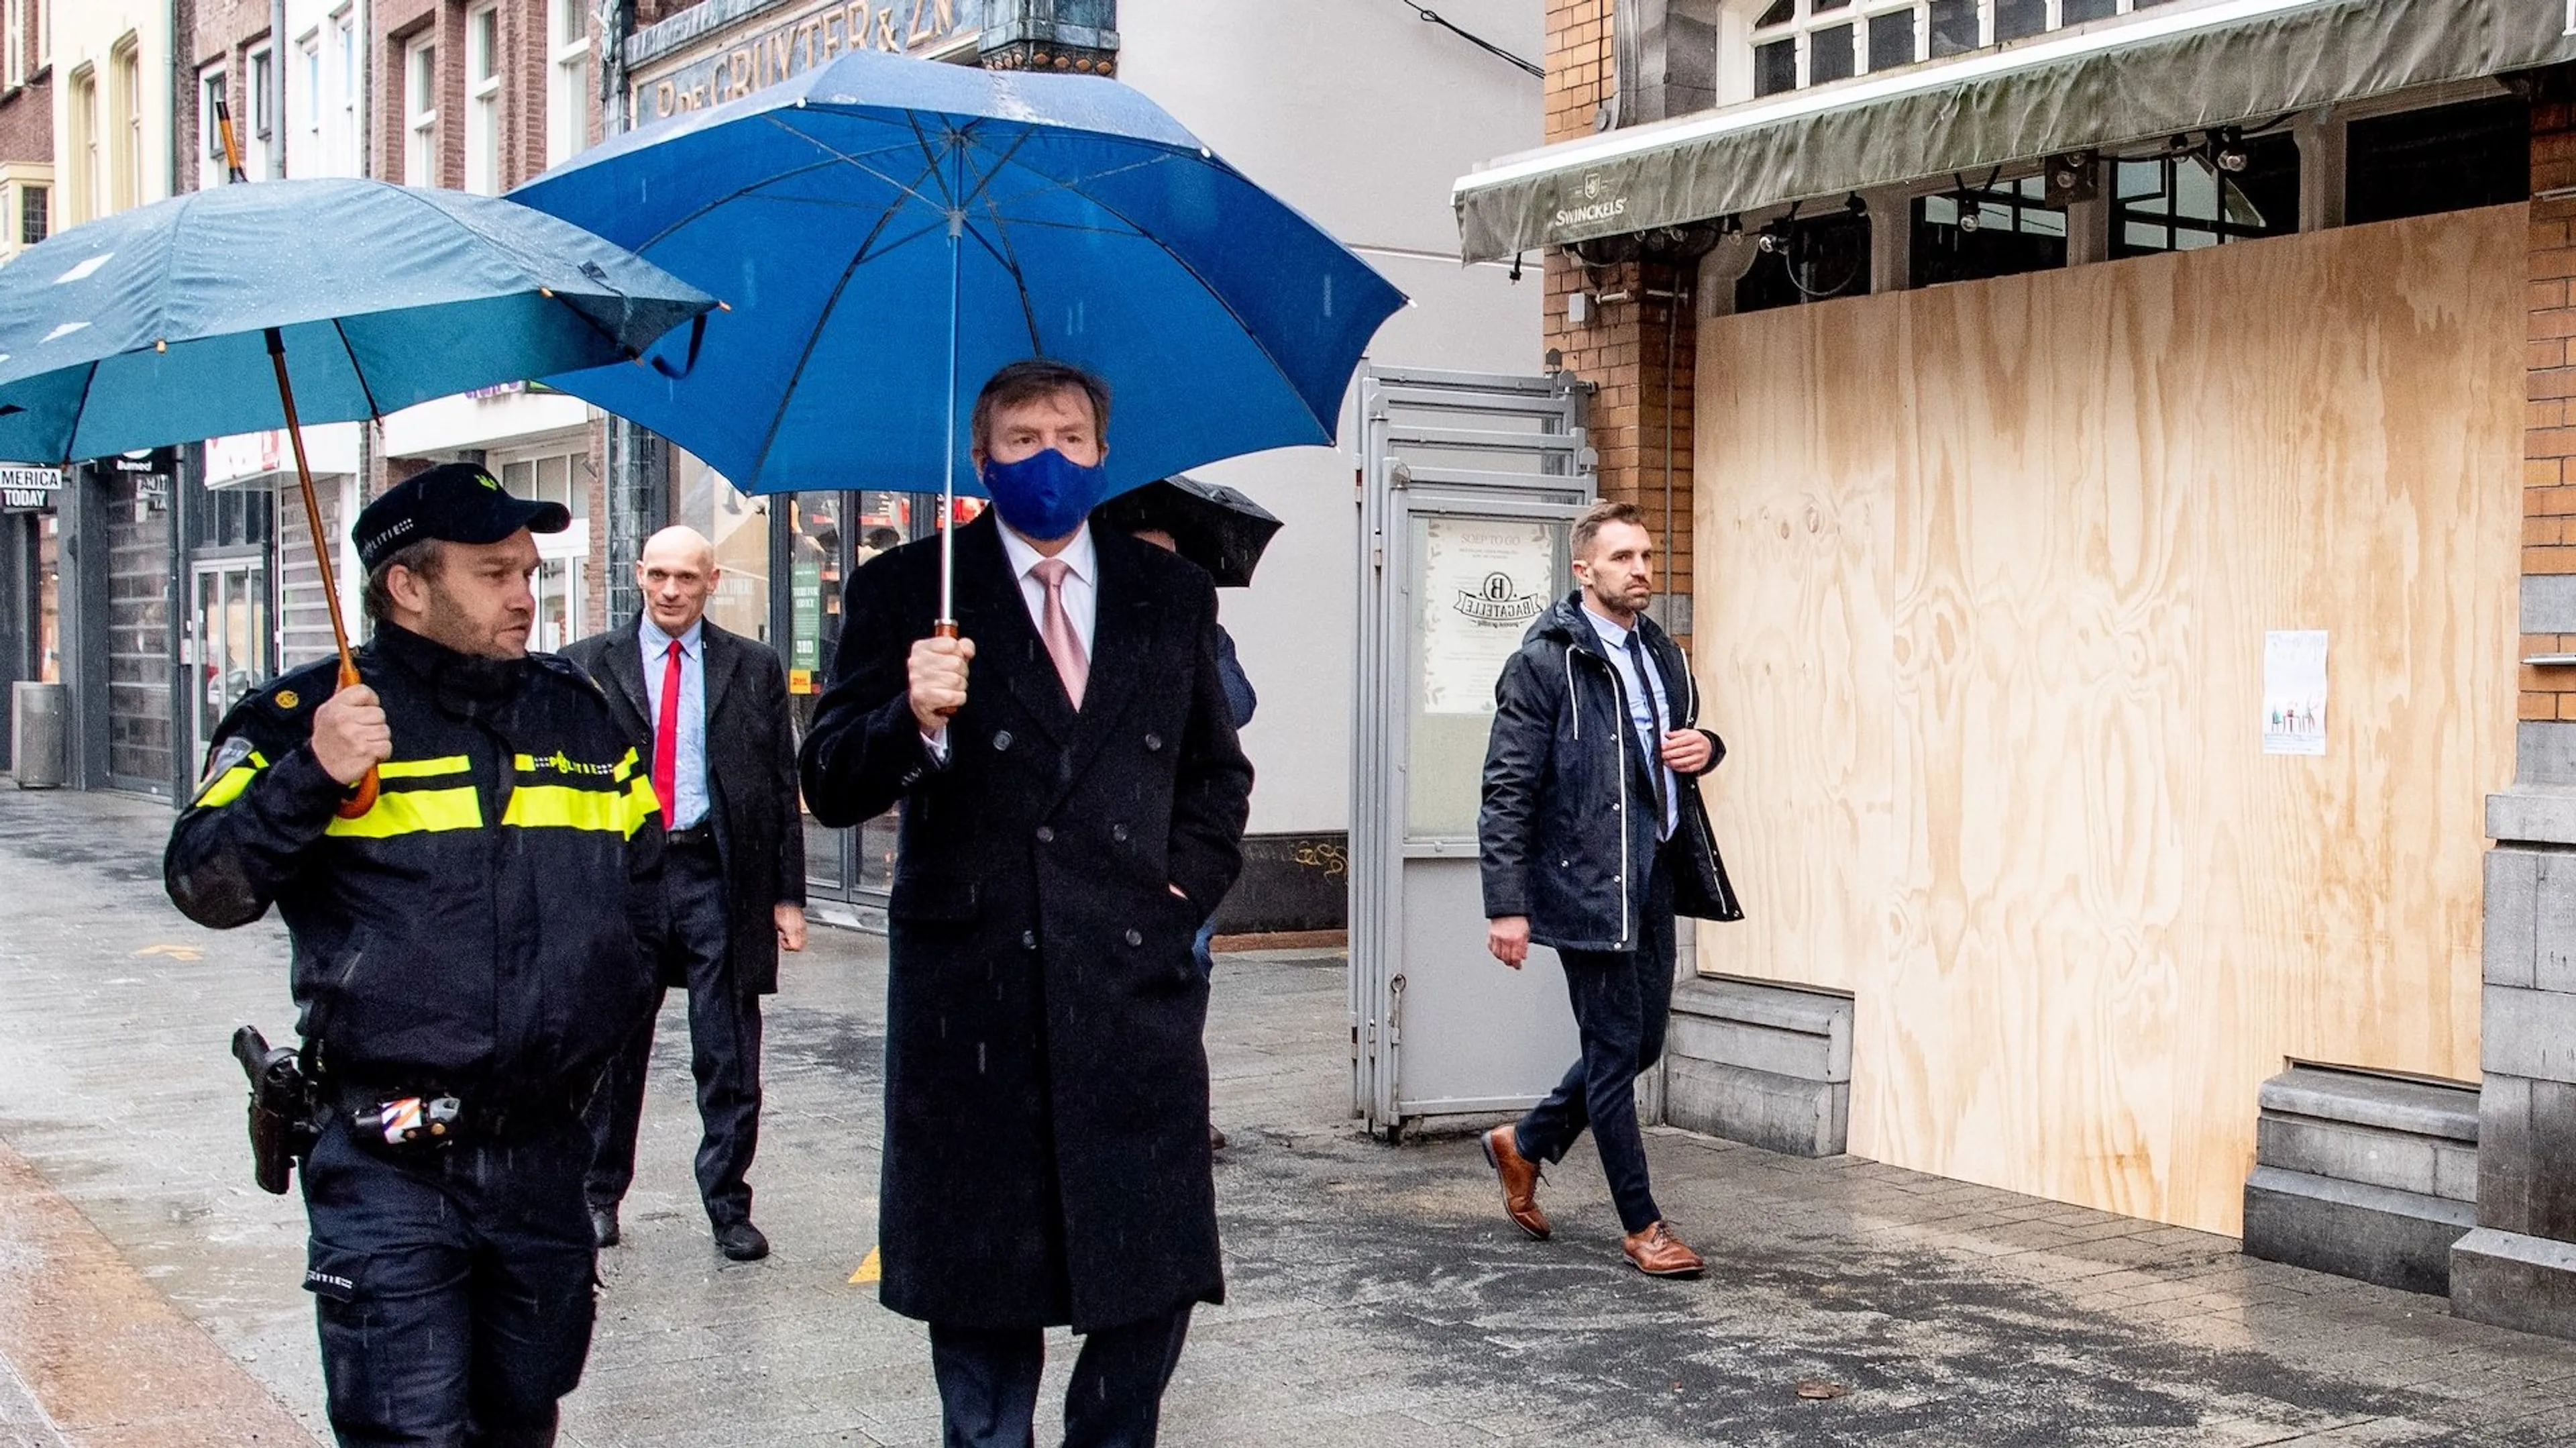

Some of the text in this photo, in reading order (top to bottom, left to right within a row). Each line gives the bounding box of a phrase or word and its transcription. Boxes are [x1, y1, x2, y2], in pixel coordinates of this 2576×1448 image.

[710, 1, 871, 108] GRUYTER
[877, 7, 901, 54] &
[3, 490, 46, 507] TODAY
